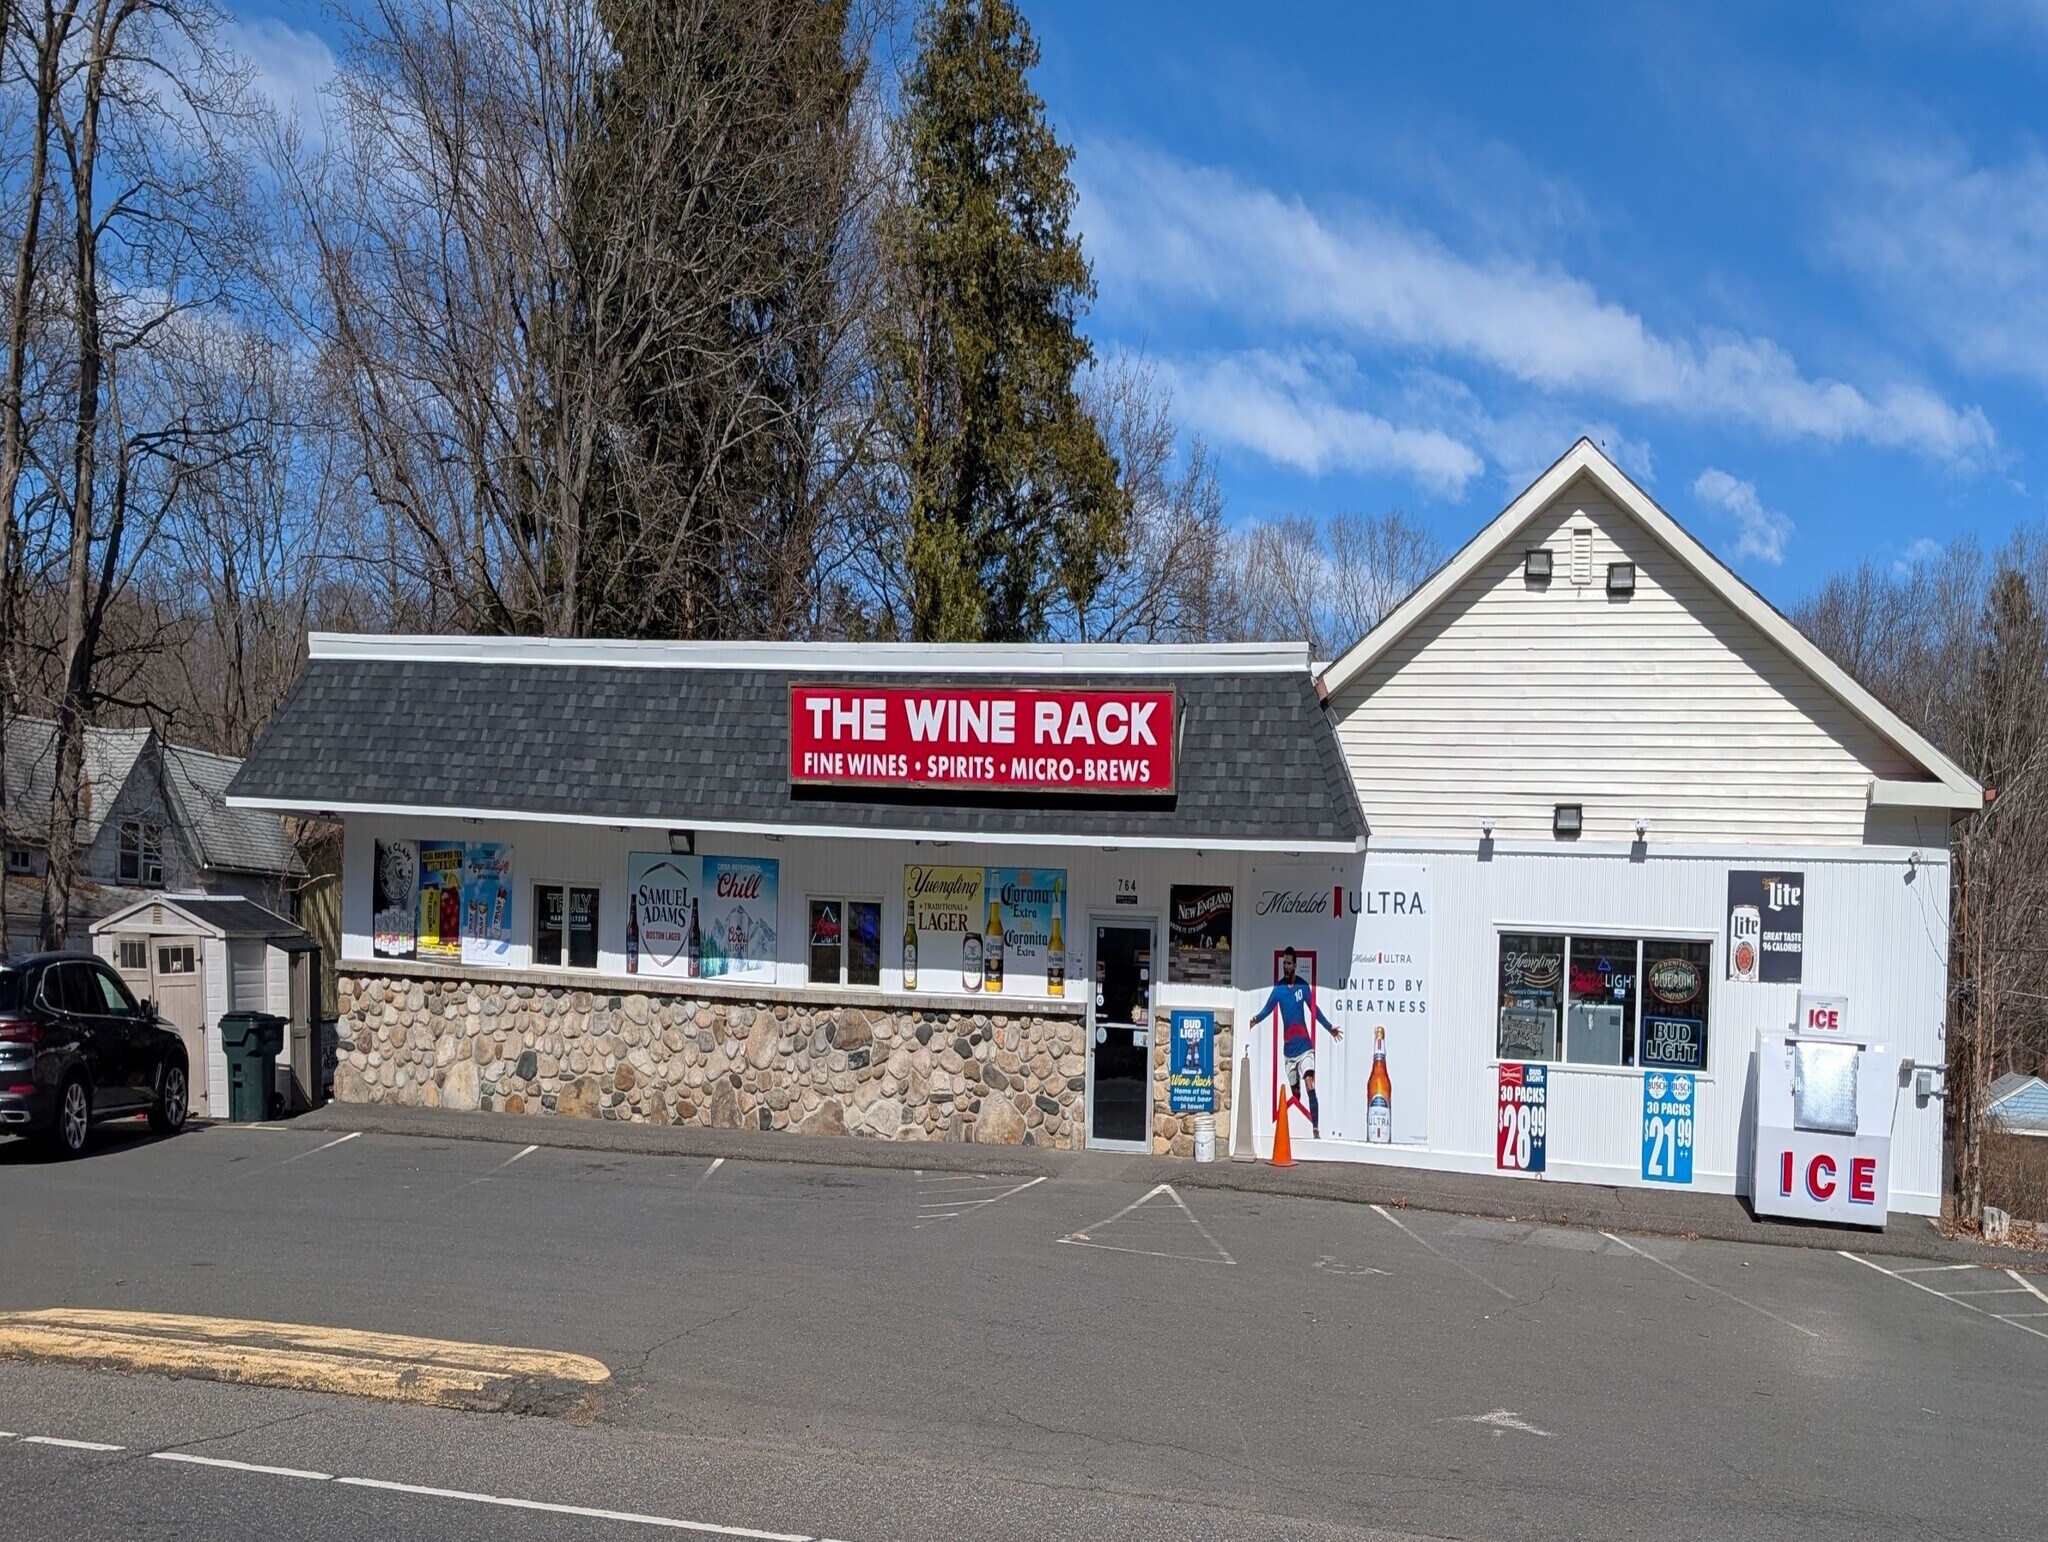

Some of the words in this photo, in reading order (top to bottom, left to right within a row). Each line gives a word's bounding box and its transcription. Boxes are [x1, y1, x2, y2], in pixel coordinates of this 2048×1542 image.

[806, 697, 887, 741] THE
[904, 699, 1016, 744] WINE
[1034, 701, 1158, 746] RACK
[804, 752, 844, 775] FINE
[847, 753, 908, 777] WINES
[927, 756, 995, 780] SPIRITS
[1010, 758, 1151, 783] MICRO-BREWS
[393, 842, 413, 861] CLAW
[717, 872, 763, 900] Chill
[907, 867, 981, 901] Yuengling
[1118, 879, 1137, 892] 764
[639, 884, 691, 909] SAMUEL
[1000, 883, 1049, 909] Corona
[1255, 890, 1330, 916] Michelob
[1349, 891, 1424, 915] ULTRA
[1768, 882, 1801, 912] Lite
[493, 900, 502, 925] TRULY
[924, 902, 965, 911] TRADITIONAL
[1013, 904, 1038, 919] Extra
[1178, 904, 1197, 920] NEW
[1196, 892, 1232, 917] ENGLAND
[642, 905, 687, 928] ADAMS
[918, 912, 968, 932] LAGER
[1733, 915, 1759, 940] Lite
[645, 930, 665, 940] BOSTON
[665, 932, 682, 942] LAGER
[1004, 928, 1048, 949] Coronita
[1763, 931, 1783, 941] GREAT
[1783, 932, 1802, 942] TASTE
[1016, 945, 1036, 958] Extra
[1762, 942, 1772, 951] 96
[1772, 942, 1802, 952] CALORIES
[1384, 954, 1412, 964] ULTRA
[1504, 951, 1561, 974] Yuengling
[1338, 978, 1396, 991] UNITED
[1405, 979, 1423, 992] BY
[1604, 973, 1636, 989] LIGHT
[1294, 988, 1303, 1002] 10
[1659, 989, 1687, 1000] COMPANY
[1335, 999, 1426, 1013] GREATNESS
[1183, 1019, 1201, 1029] BUD
[1808, 1009, 1839, 1030] ICE
[1180, 1028, 1204, 1039] LIGHT
[1654, 1021, 1691, 1041] BUD
[1646, 1039, 1698, 1063] LIGHT
[1526, 1074, 1544, 1082] LIGHT
[1528, 1068, 1542, 1076] BUD
[1171, 1074, 1191, 1086] Wine
[1191, 1075, 1214, 1087] Rack
[1647, 1080, 1668, 1091] BUSCH
[1671, 1082, 1692, 1092] BUSCH
[1174, 1087, 1192, 1095] Home
[1501, 1085, 1513, 1101] 30
[1514, 1086, 1545, 1103] PACKS
[1647, 1101, 1660, 1114] 30
[1661, 1102, 1691, 1116] PACKS
[1780, 1151, 1876, 1205] ICE
